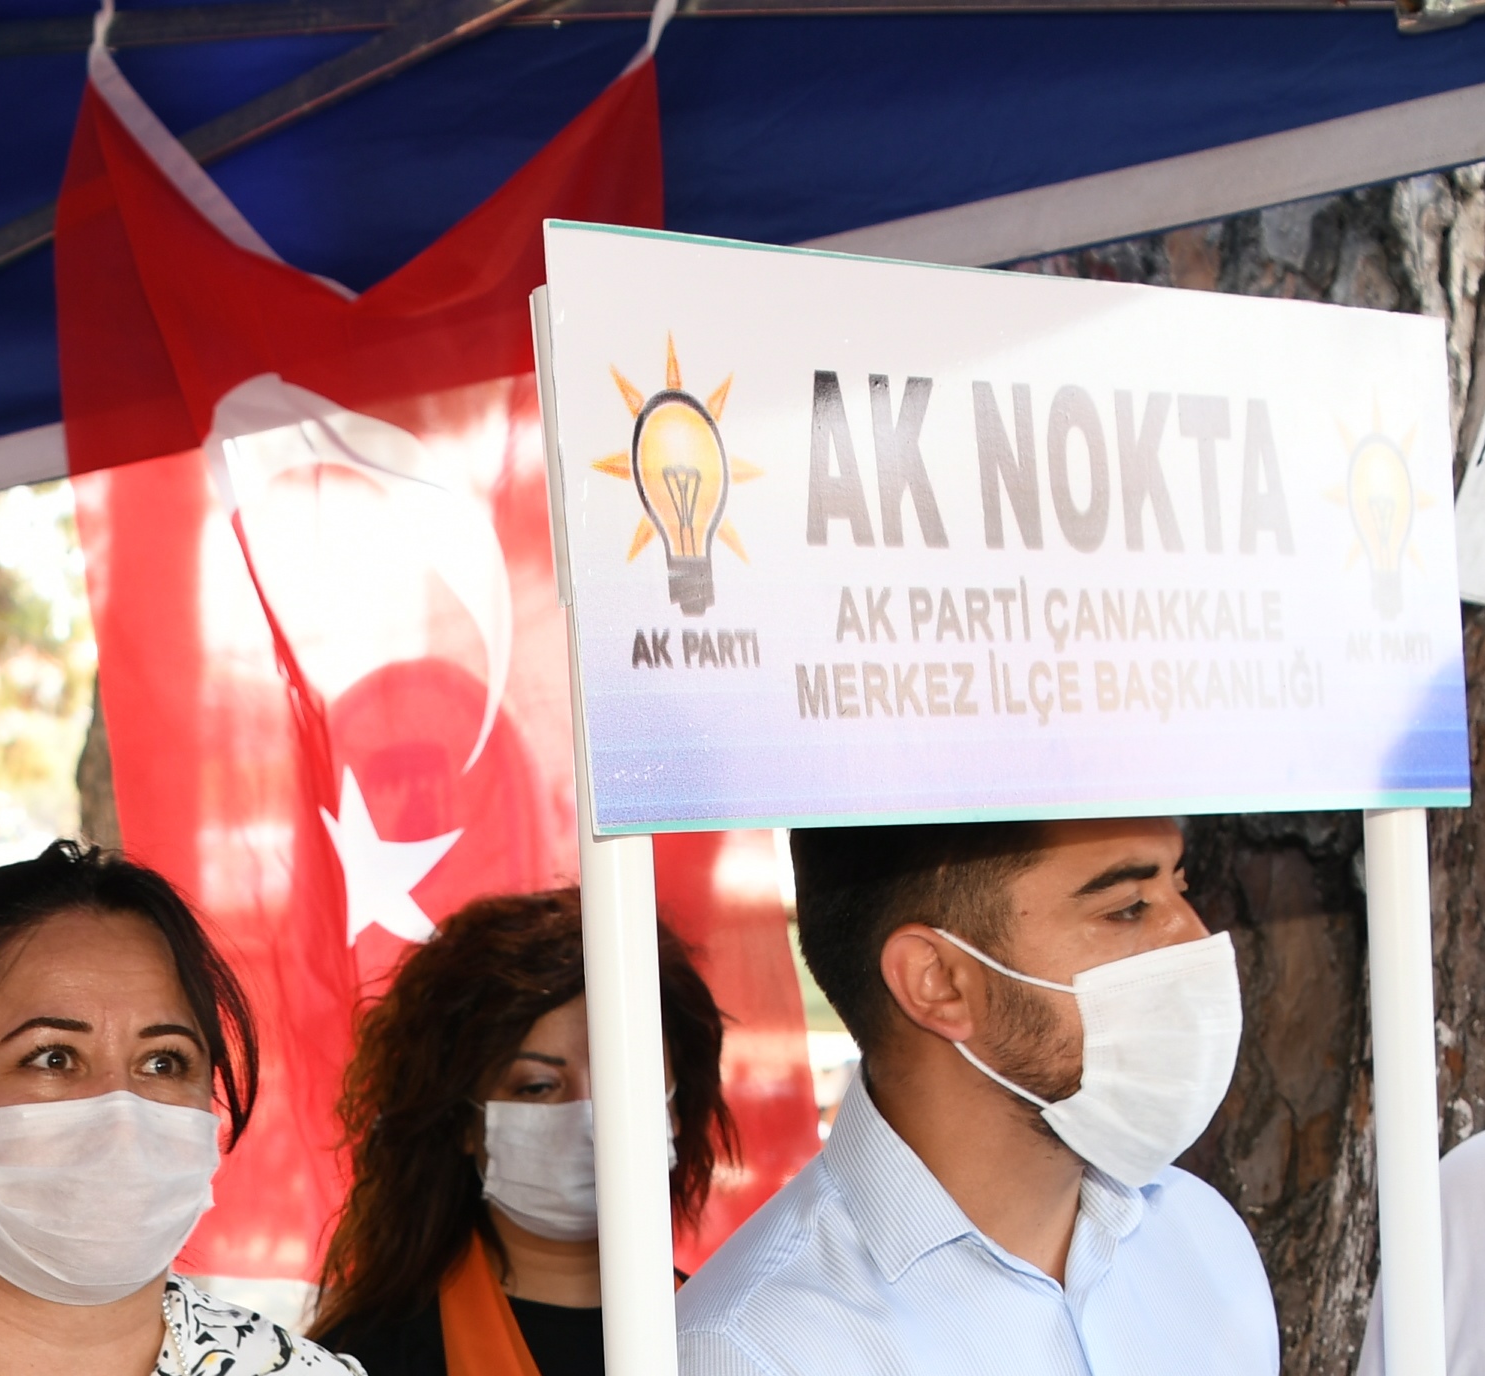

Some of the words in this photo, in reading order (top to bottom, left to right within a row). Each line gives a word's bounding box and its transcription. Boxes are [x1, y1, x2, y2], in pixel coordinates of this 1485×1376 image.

[807, 370, 949, 547] AK
[972, 380, 1295, 555] NOKTA
[632, 628, 673, 669] AK
[836, 586, 896, 643] AK
[908, 576, 1031, 643] PARTİ
[1044, 587, 1283, 653] ÇANAKKALE
[795, 661, 978, 720] MERKEZ
[989, 648, 1082, 726] İLÇE
[1094, 647, 1324, 723] BAŞKANLIĞI
